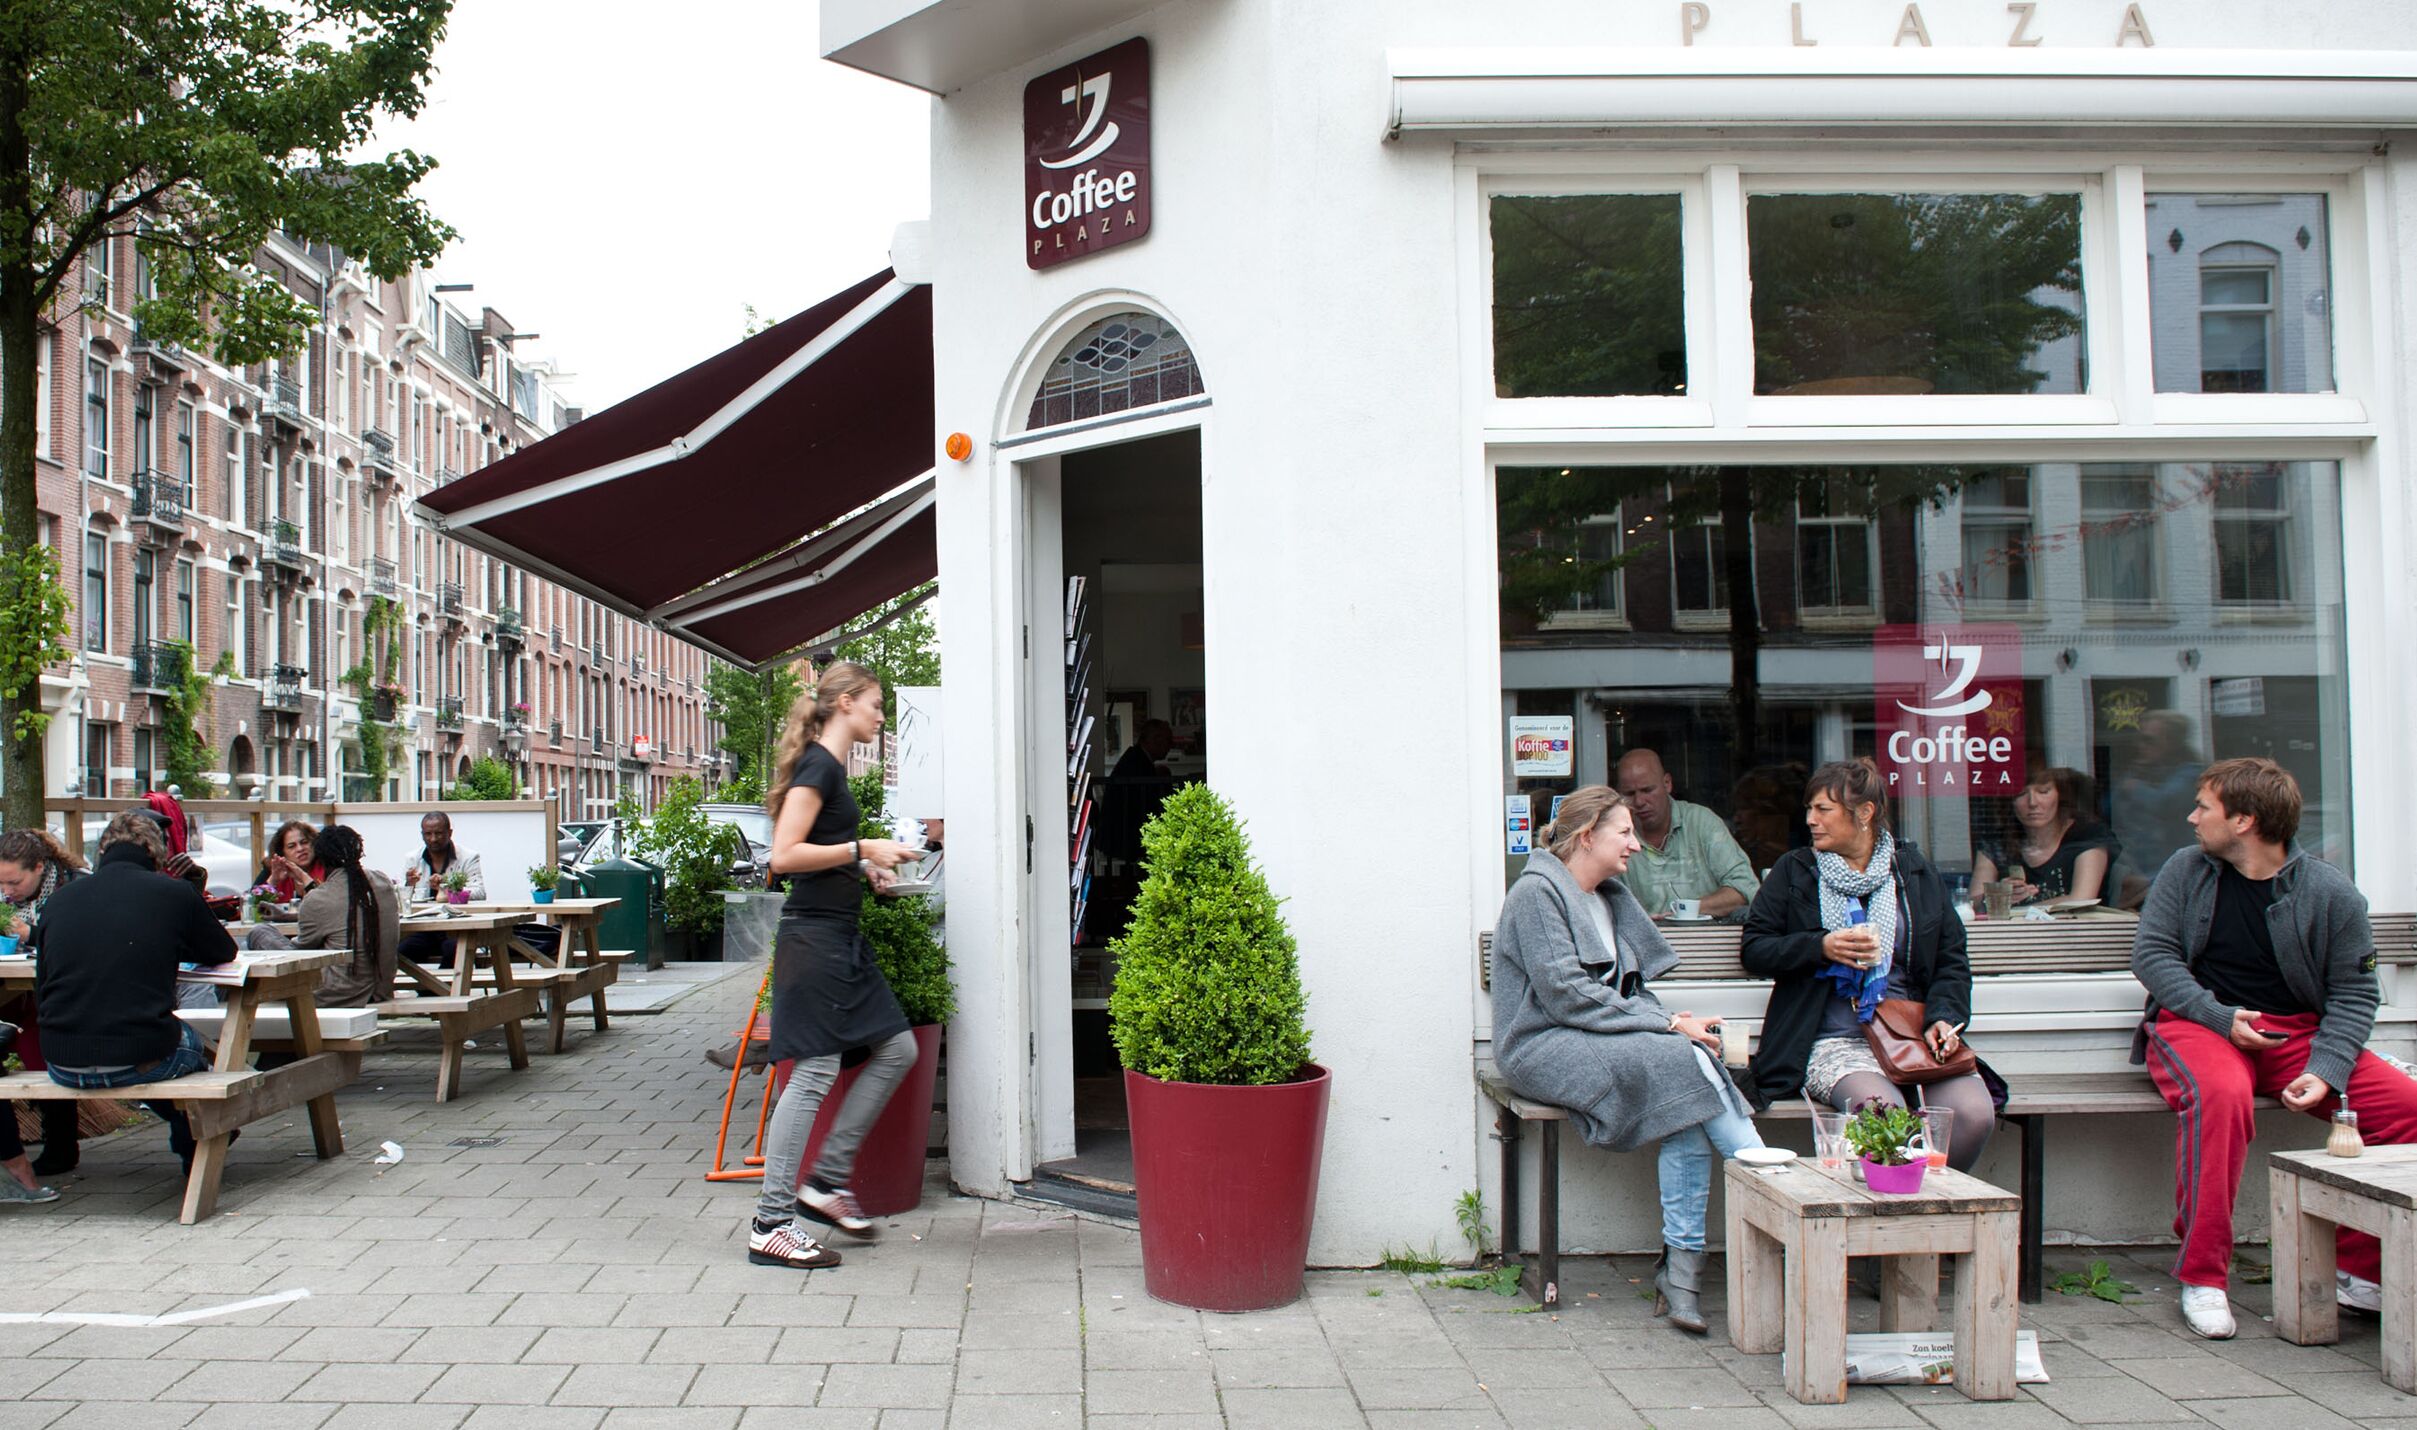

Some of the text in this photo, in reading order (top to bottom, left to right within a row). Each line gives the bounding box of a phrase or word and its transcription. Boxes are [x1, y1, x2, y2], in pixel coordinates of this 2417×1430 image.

[1681, 2, 2156, 47] PLAZA
[1032, 168, 1137, 229] Coffee
[1033, 209, 1136, 255] PLAZA
[1518, 739, 1549, 752] Koffie
[1888, 725, 2012, 764] Coffee
[1889, 770, 2011, 785] PLAZA
[1912, 1344, 1930, 1353] Zon
